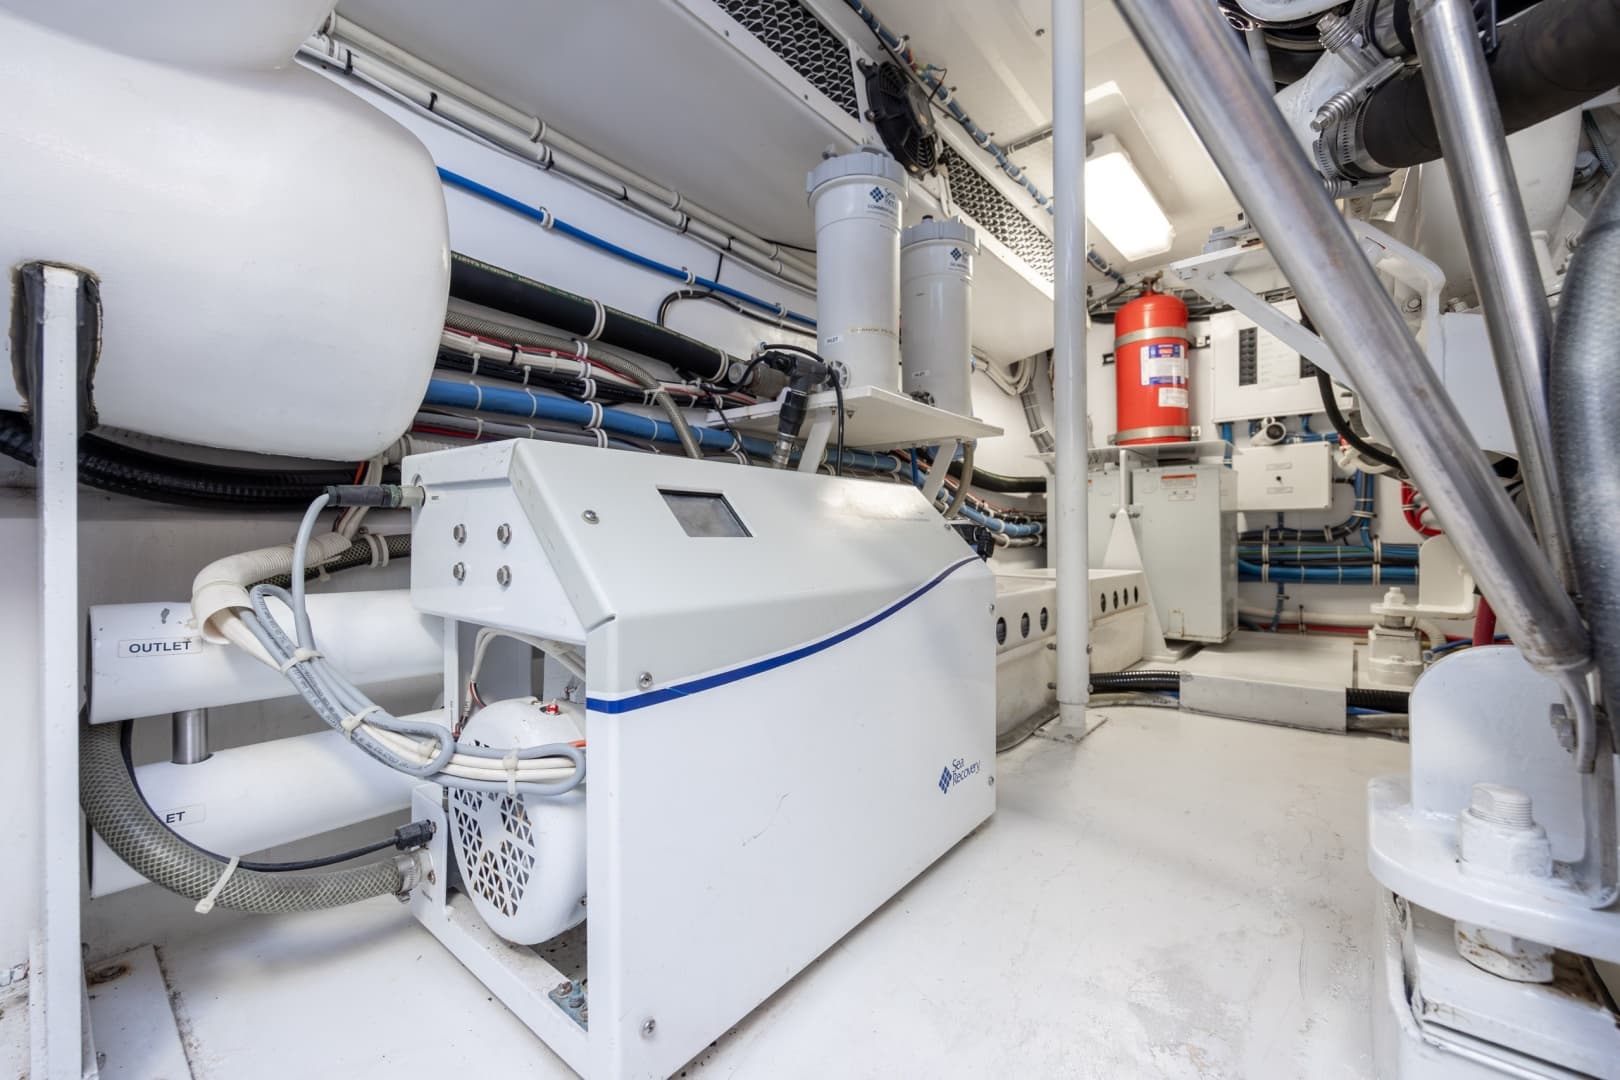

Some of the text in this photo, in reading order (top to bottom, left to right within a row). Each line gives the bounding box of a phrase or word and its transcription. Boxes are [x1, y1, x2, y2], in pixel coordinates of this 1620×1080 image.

[128, 640, 192, 654] OUTLET
[951, 757, 966, 772] Sea
[952, 759, 982, 787] Recovery
